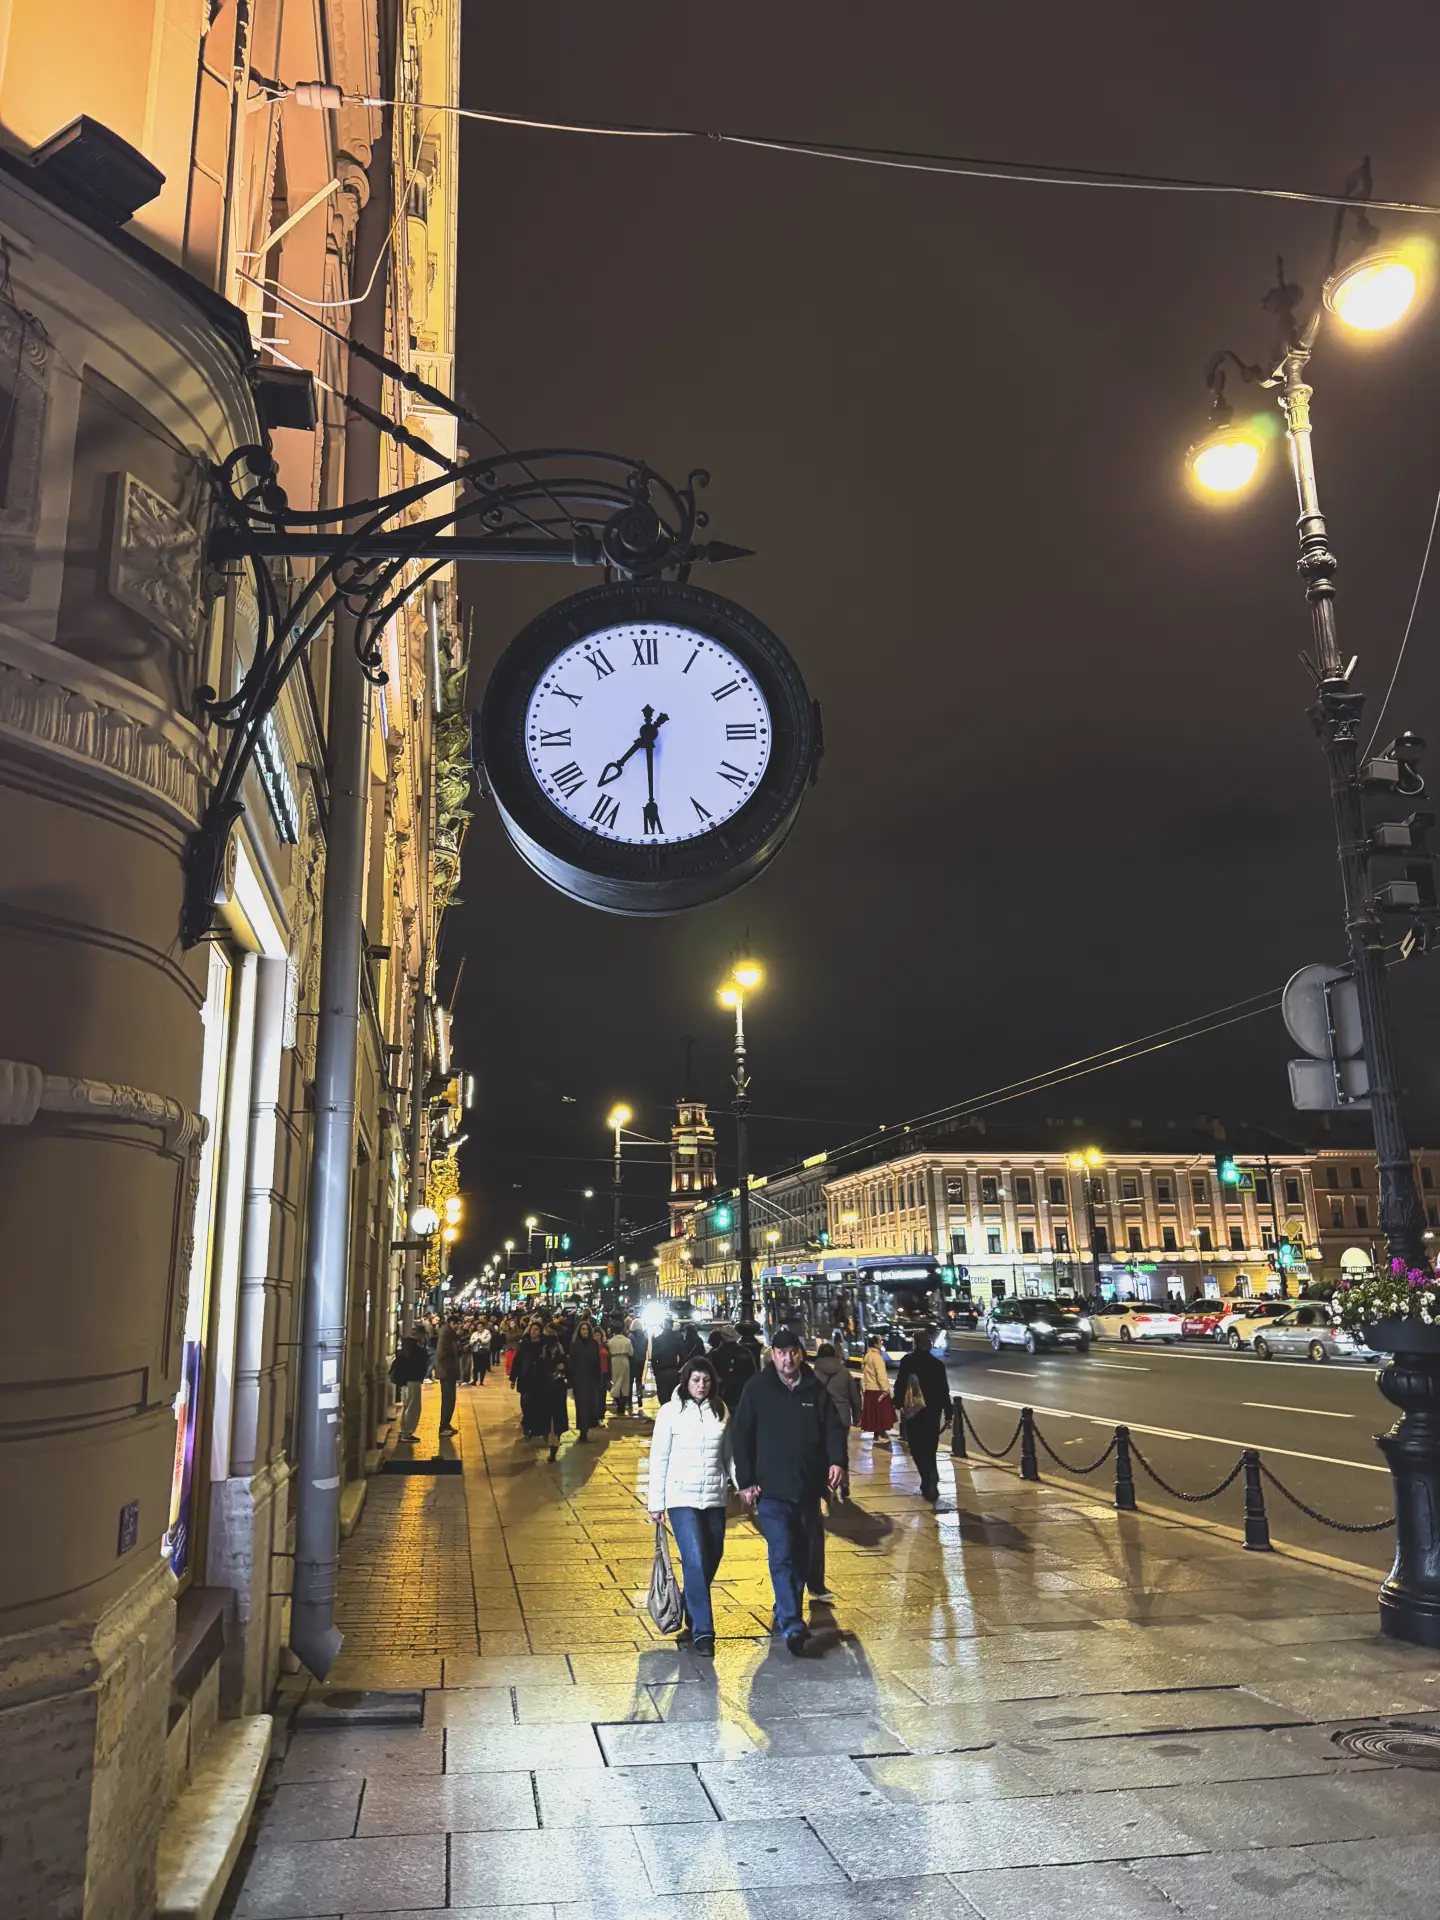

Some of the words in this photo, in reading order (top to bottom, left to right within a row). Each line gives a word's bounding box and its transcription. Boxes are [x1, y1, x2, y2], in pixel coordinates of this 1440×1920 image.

[583, 649, 616, 680] XI
[632, 639, 658, 665] XII
[682, 649, 700, 674] I
[551, 684, 583, 707] X
[711, 680, 741, 702] II
[540, 728, 571, 747] IX
[726, 723, 756, 741] III
[550, 761, 587, 799] VIII
[716, 761, 749, 789] IV
[588, 793, 620, 830] VII
[690, 797, 713, 822] V
